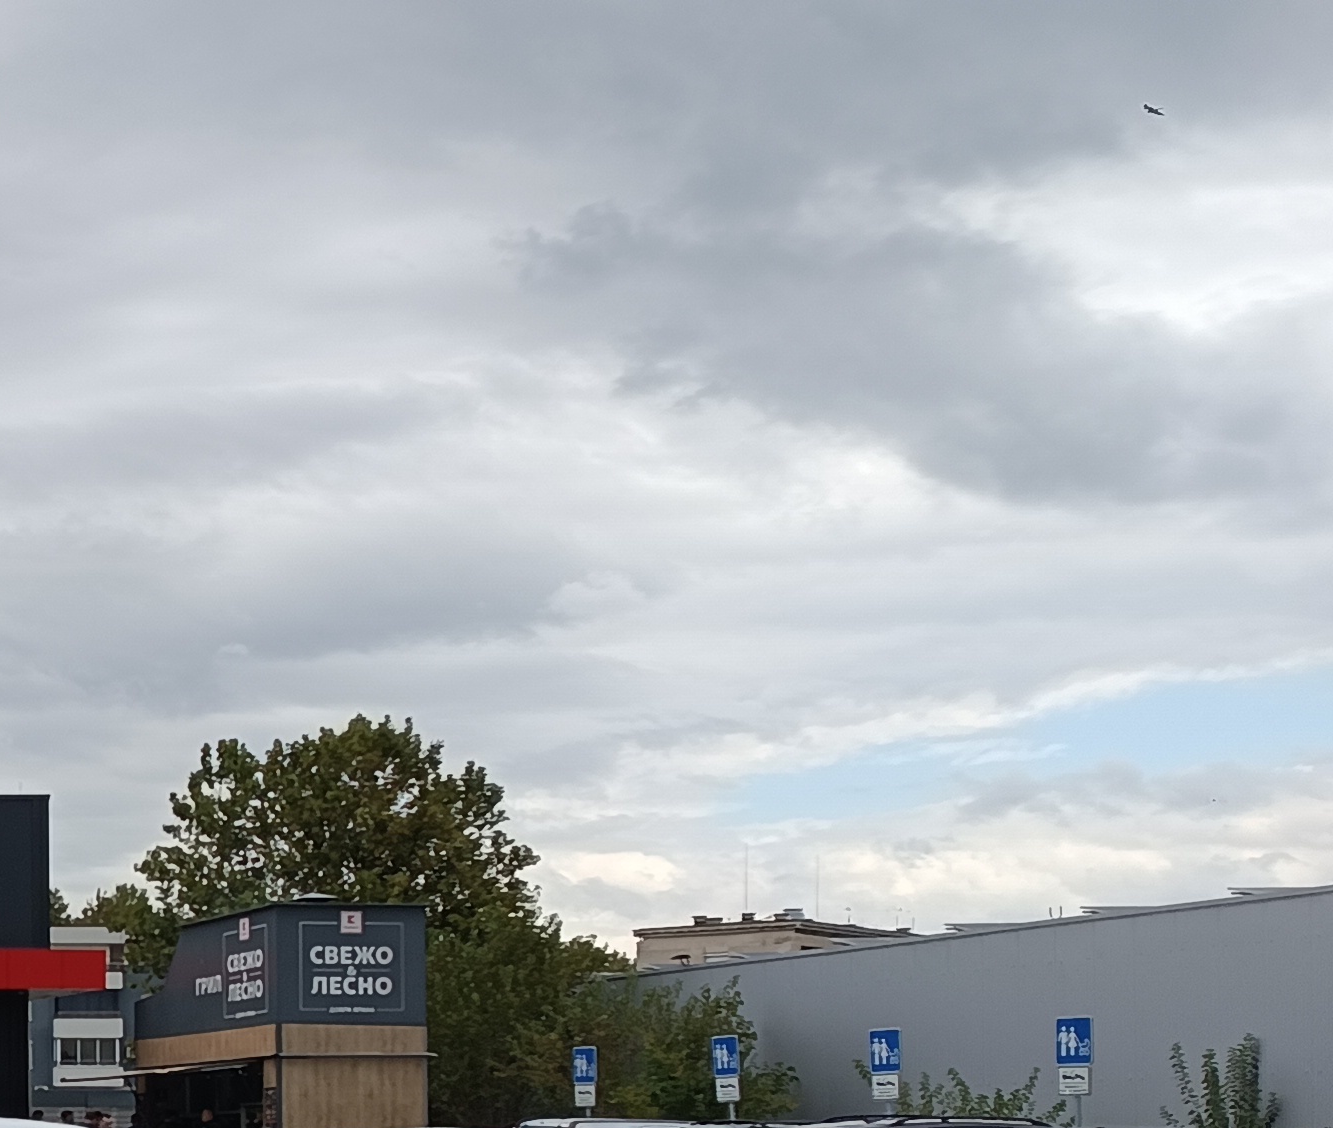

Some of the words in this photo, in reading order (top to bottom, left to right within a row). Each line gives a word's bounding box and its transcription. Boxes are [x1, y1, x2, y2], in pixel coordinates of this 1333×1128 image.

[226, 949, 264, 973] СВЕЖО
[309, 945, 394, 965] СВЕЖО
[195, 974, 223, 997] ГРИЛ
[227, 979, 264, 1002] ЛЕСНО
[310, 976, 393, 996] ЛЕСНО
